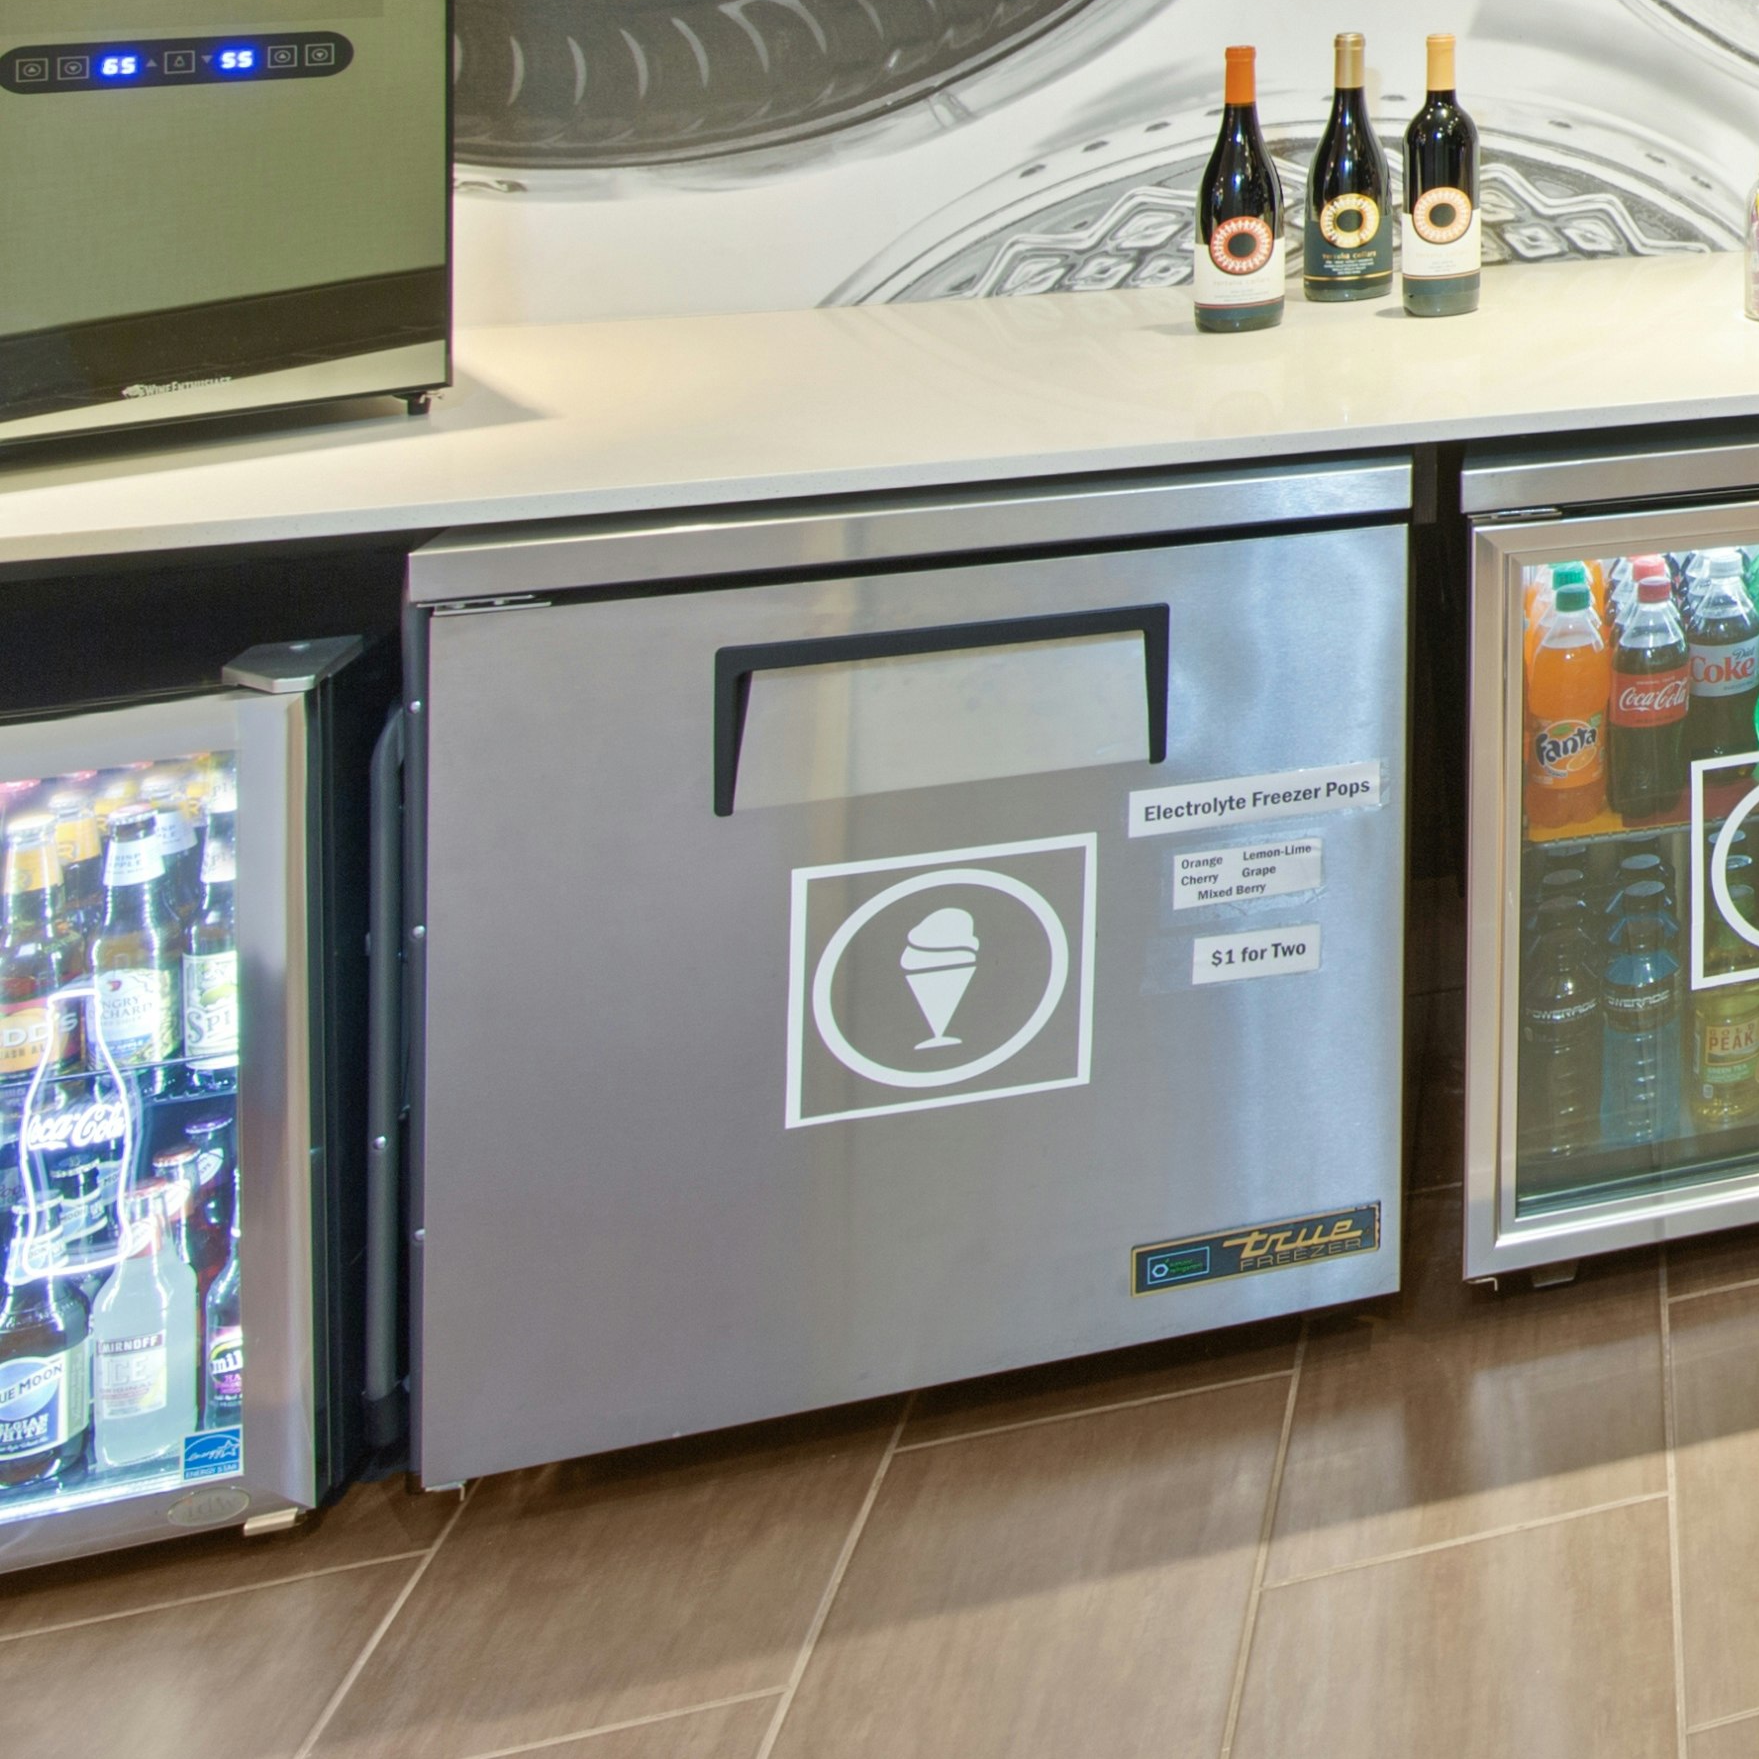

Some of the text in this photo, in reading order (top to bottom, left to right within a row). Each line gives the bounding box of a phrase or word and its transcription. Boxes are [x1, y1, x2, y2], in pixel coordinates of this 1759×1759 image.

[102, 56, 138, 76] 65
[220, 49, 254, 71] 55
[1690, 654, 1754, 684] Coke
[1619, 680, 1688, 712] Coca-Cola
[1144, 778, 1371, 823] Electrolyte Freezer Pops
[1181, 855, 1223, 870] Orange
[1242, 844, 1312, 861] Lemon-Lime
[1181, 872, 1219, 888] Cherry
[1241, 864, 1276, 880] Grape
[1198, 882, 1267, 901] Mixed Berry
[1211, 941, 1306, 968] $1 for Two
[101, 996, 140, 1011] NGRY
[188, 1005, 232, 1042] SPI
[1708, 1029, 1755, 1052] PEAK
[1223, 1219, 1363, 1258] true
[1240, 1238, 1362, 1271] FREEZER
[18, 1363, 64, 1392] MOON
